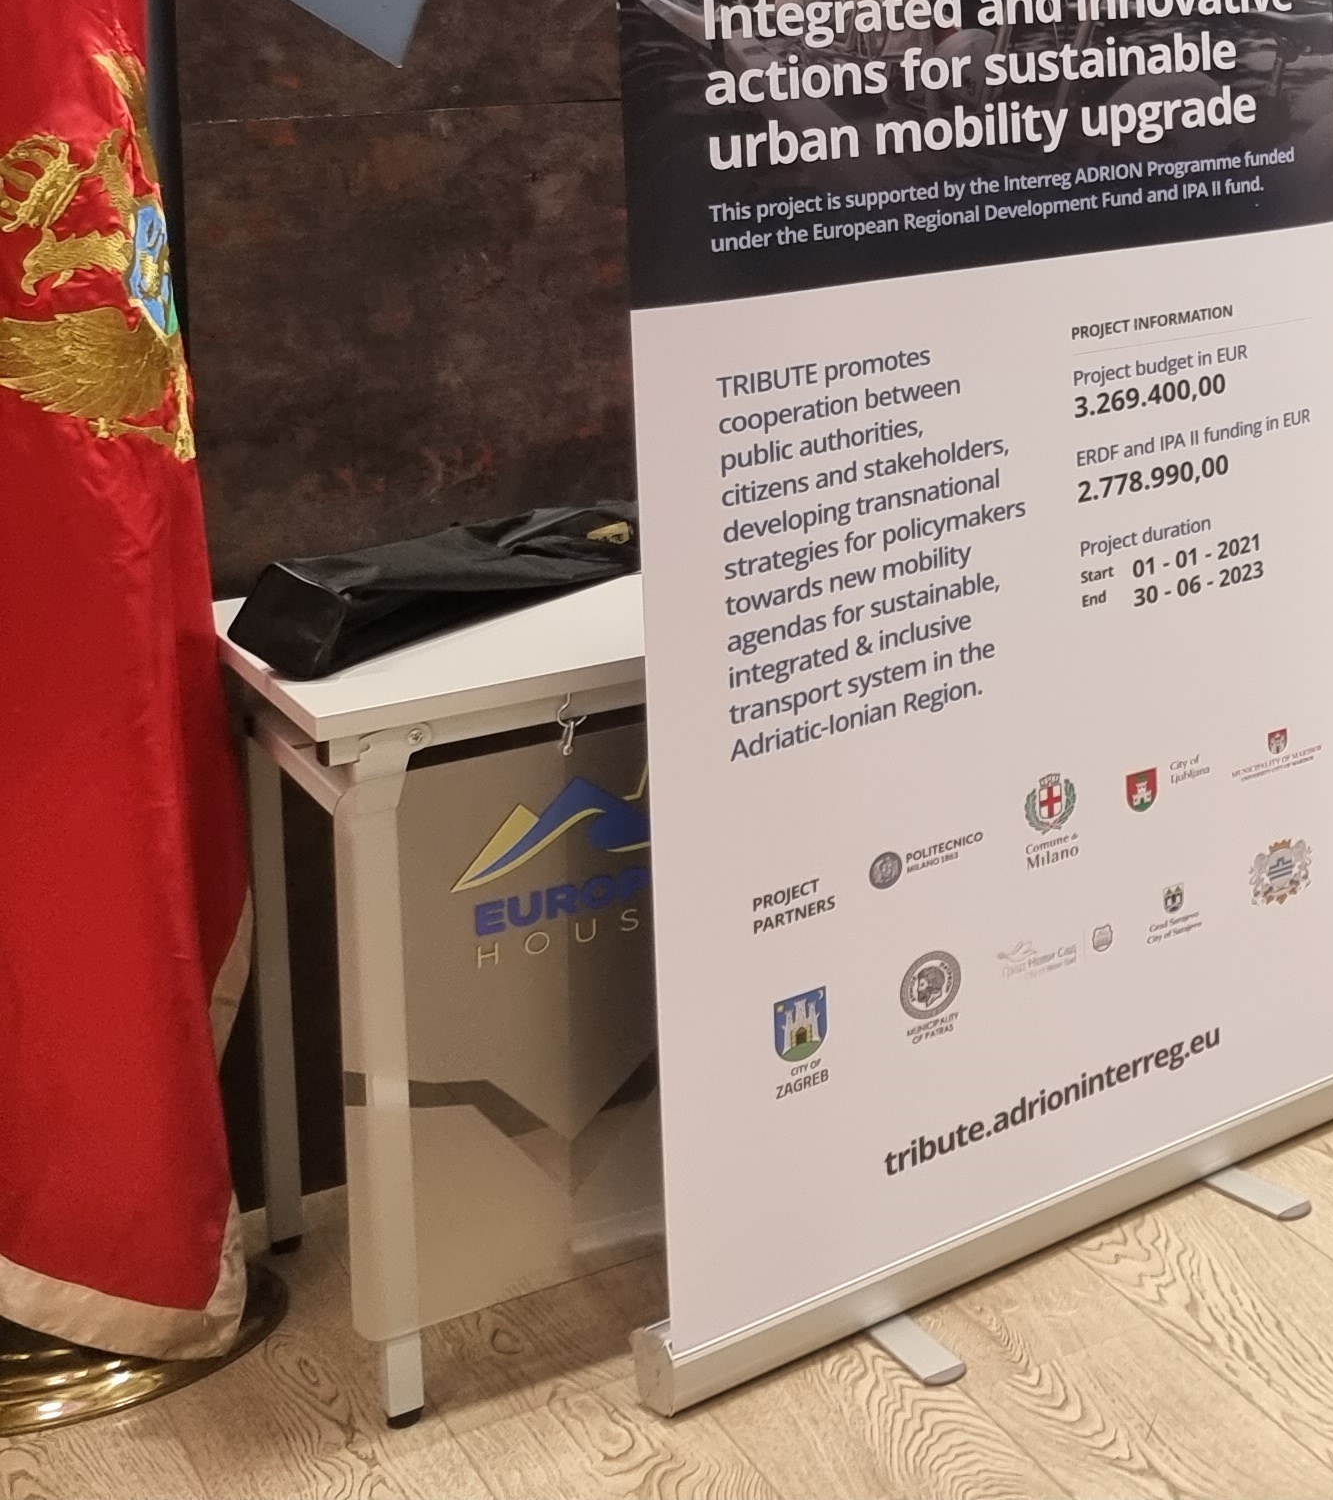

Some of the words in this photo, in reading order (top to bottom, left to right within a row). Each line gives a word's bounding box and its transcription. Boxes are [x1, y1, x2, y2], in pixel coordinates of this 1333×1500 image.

[706, 55, 887, 105] actions
[901, 48, 971, 90] for
[985, 31, 1236, 85] sustainable
[710, 120, 859, 170] urban
[876, 101, 1068, 155] mobility
[1082, 86, 1256, 146] upgrade
[709, 202, 751, 222] This
[757, 196, 822, 223] project
[827, 193, 841, 210] is
[846, 182, 938, 211] supported
[944, 181, 965, 201] by
[970, 178, 999, 194] the
[1004, 173, 1071, 191] Interreg
[1075, 162, 1142, 184] ADRION
[1147, 156, 1241, 178] Programme
[1244, 147, 1294, 167] funded
[711, 231, 772, 252] under
[776, 226, 808, 245] the
[813, 218, 898, 241] European
[904, 205, 979, 232] Regional
[985, 195, 1098, 221] Development
[1102, 188, 1142, 208] Fund
[1147, 184, 1178, 203] and
[1183, 182, 1208, 199] IPA
[1212, 181, 1221, 196] II
[1225, 176, 1264, 194] fund.
[1072, 319, 1130, 340] PROJECT
[1134, 305, 1232, 330] INFORMATION
[716, 363, 817, 398] TRIBUTE
[825, 350, 930, 388] promotes
[1074, 364, 1131, 387] Project
[1136, 355, 1193, 376] budget
[1198, 351, 1211, 366] in
[1217, 345, 1247, 363] EUR
[719, 396, 857, 434] cooperation
[865, 380, 960, 409] between
[1075, 374, 1225, 418] 3.269.400,00
[721, 440, 793, 478] public
[800, 419, 923, 456] authorities,
[1077, 445, 1118, 467] ERDF
[1124, 437, 1154, 458] and
[1161, 433, 1186, 451] IPA
[1191, 430, 1198, 445] II
[1204, 422, 1262, 443] funding
[1267, 415, 1278, 431] in
[1284, 409, 1310, 427] EUR
[722, 476, 809, 506] citizens
[816, 461, 857, 489] and
[864, 439, 1008, 479] stakeholders,
[1078, 455, 1228, 503] 2.778.990,00
[723, 503, 851, 543] developing
[856, 468, 999, 515] transnational
[725, 541, 839, 580] strategies
[844, 531, 876, 553] for
[883, 502, 1025, 552] policymakers
[1081, 532, 1138, 557] Project
[1142, 519, 1211, 543] duration
[1081, 566, 1114, 584] Start
[1133, 557, 1154, 578] 01
[1176, 548, 1196, 568] 01
[1218, 534, 1259, 560] 2021
[725, 577, 823, 615] towards
[830, 567, 876, 593] new
[883, 546, 971, 580] mobility
[1082, 590, 1106, 607] End
[1134, 585, 1158, 607] 30
[1177, 575, 1201, 596] 06
[1219, 561, 1263, 587] 2023
[728, 615, 827, 655] agendas
[832, 604, 865, 627] for
[871, 573, 1000, 619] sustainable,
[729, 638, 848, 689] integrated
[856, 635, 873, 656] &
[879, 615, 971, 651] inclusive
[729, 679, 842, 724] transport
[848, 660, 926, 698] system
[934, 651, 952, 671] in
[959, 642, 995, 664] the
[731, 702, 896, 762] Adriatic-Ionian
[904, 682, 982, 714] Region.
[1170, 760, 1188, 770] City
[1190, 754, 1200, 765] of
[906, 832, 983, 863] POLITECNICO
[1027, 846, 1079, 869] Milano
[475, 866, 650, 937] EUROP
[753, 878, 819, 912] PROJECT
[754, 896, 835, 934] PARTNERS
[477, 909, 640, 969] HOUS
[776, 1069, 829, 1099] ZAGREB
[791, 1063, 808, 1076] CITY
[810, 1058, 821, 1069] OF
[884, 1028, 1219, 1176] tribute.adrioninterreg.eu
